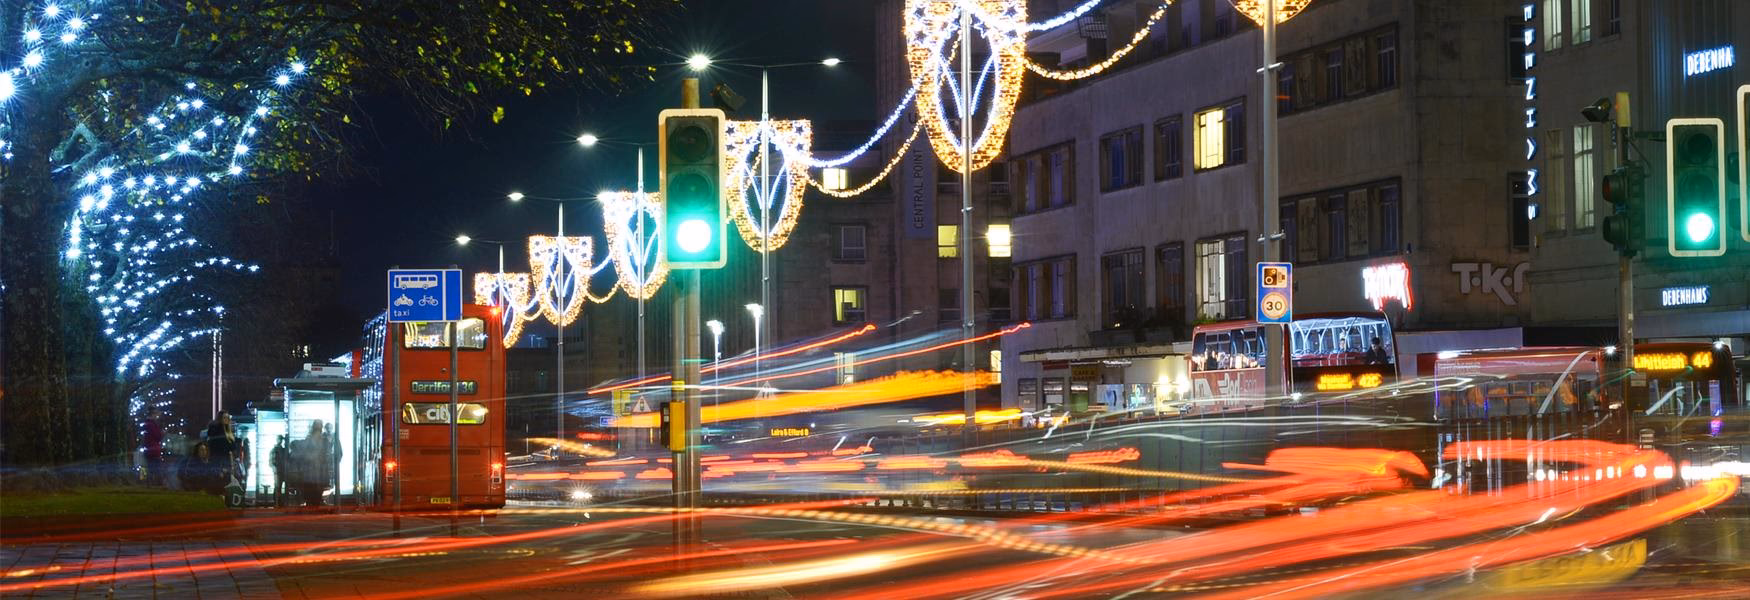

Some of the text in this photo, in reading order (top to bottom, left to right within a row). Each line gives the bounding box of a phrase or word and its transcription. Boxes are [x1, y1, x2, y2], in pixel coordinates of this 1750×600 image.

[913, 149, 924, 230] CENTRAL POINT
[1662, 287, 1707, 306] DEBENHAMS
[1266, 301, 1283, 311] 30
[1692, 353, 1711, 368] 44
[412, 381, 474, 392] Derrifor 34
